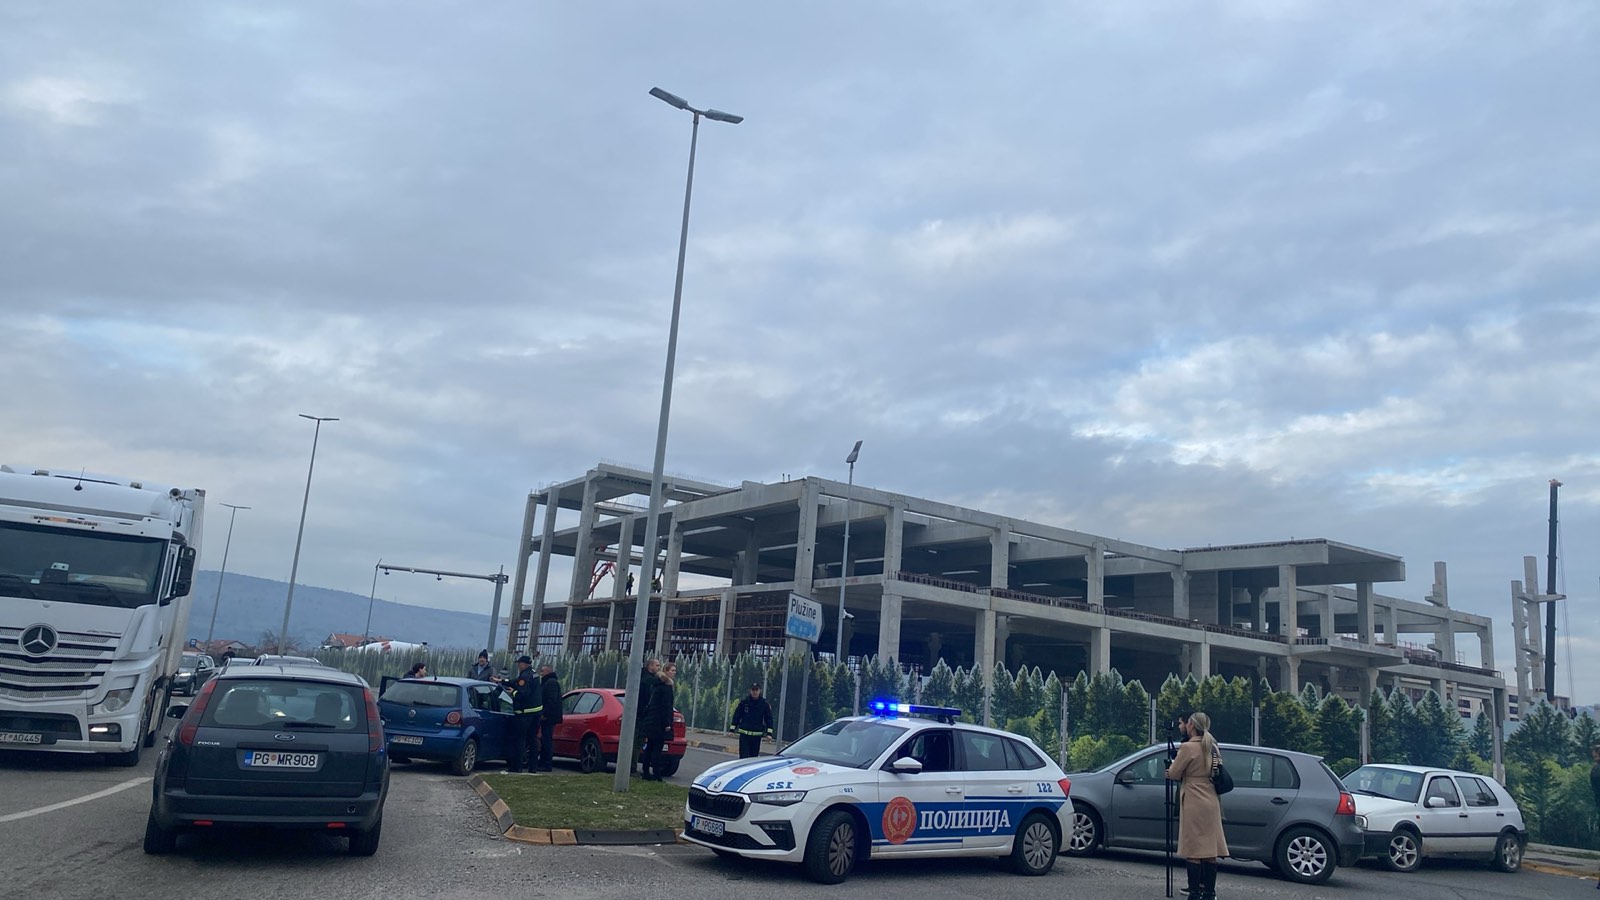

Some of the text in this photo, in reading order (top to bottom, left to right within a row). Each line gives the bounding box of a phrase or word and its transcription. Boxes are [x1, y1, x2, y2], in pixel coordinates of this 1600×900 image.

[791, 598, 816, 619] Plužine
[254, 753, 270, 765] PG
[277, 754, 316, 767] MR908
[1036, 782, 1052, 793] 122
[696, 818, 701, 828] P
[919, 809, 1010, 833] ПОЛИЦИЈА
